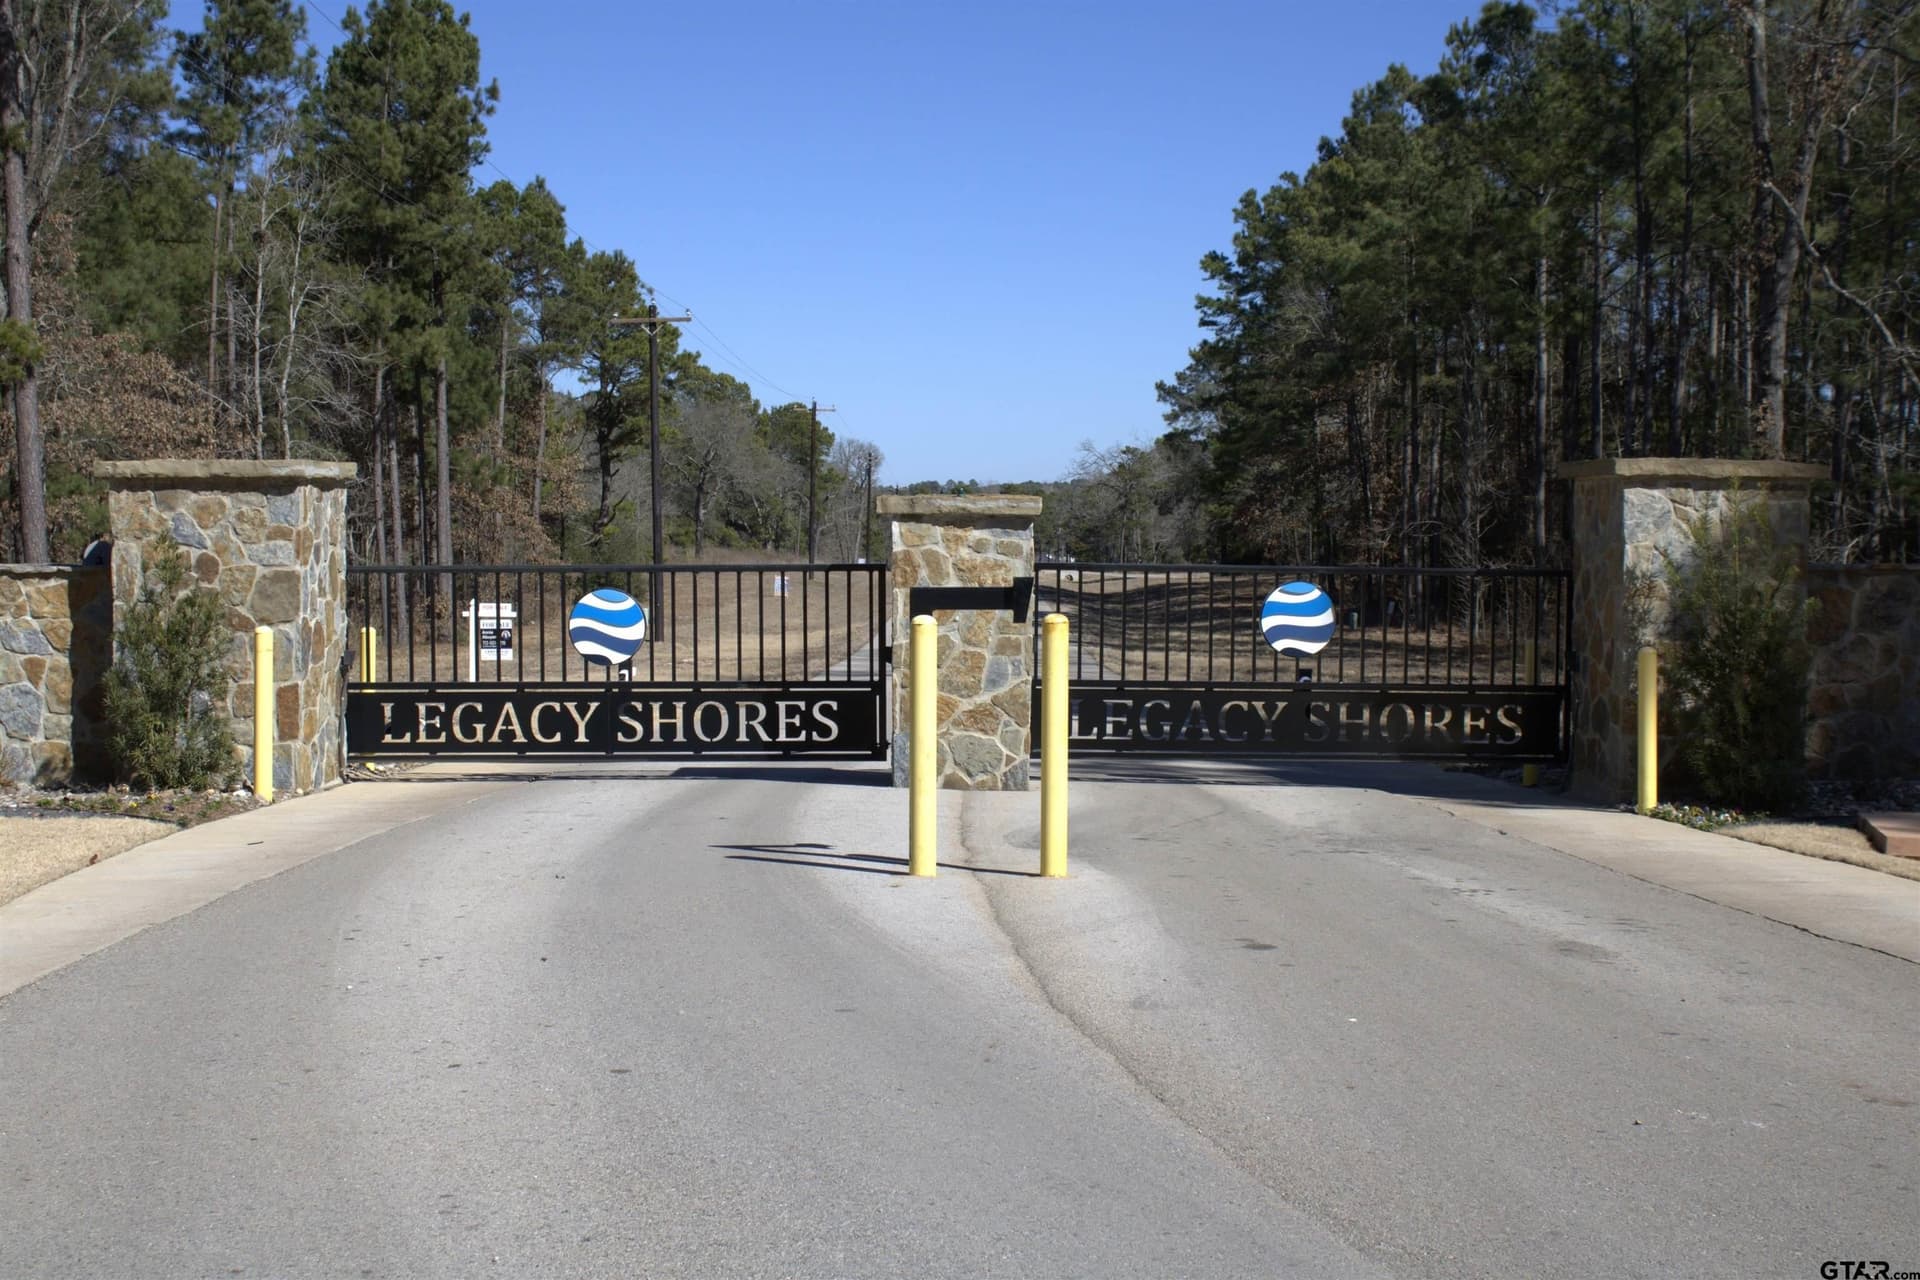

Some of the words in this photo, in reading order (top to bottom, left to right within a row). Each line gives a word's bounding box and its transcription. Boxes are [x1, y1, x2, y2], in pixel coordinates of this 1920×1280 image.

[380, 701, 600, 743] LEGACY
[616, 700, 840, 743] SHORES
[1068, 699, 1288, 742] LEGACY
[1304, 701, 1523, 745] SHORES
